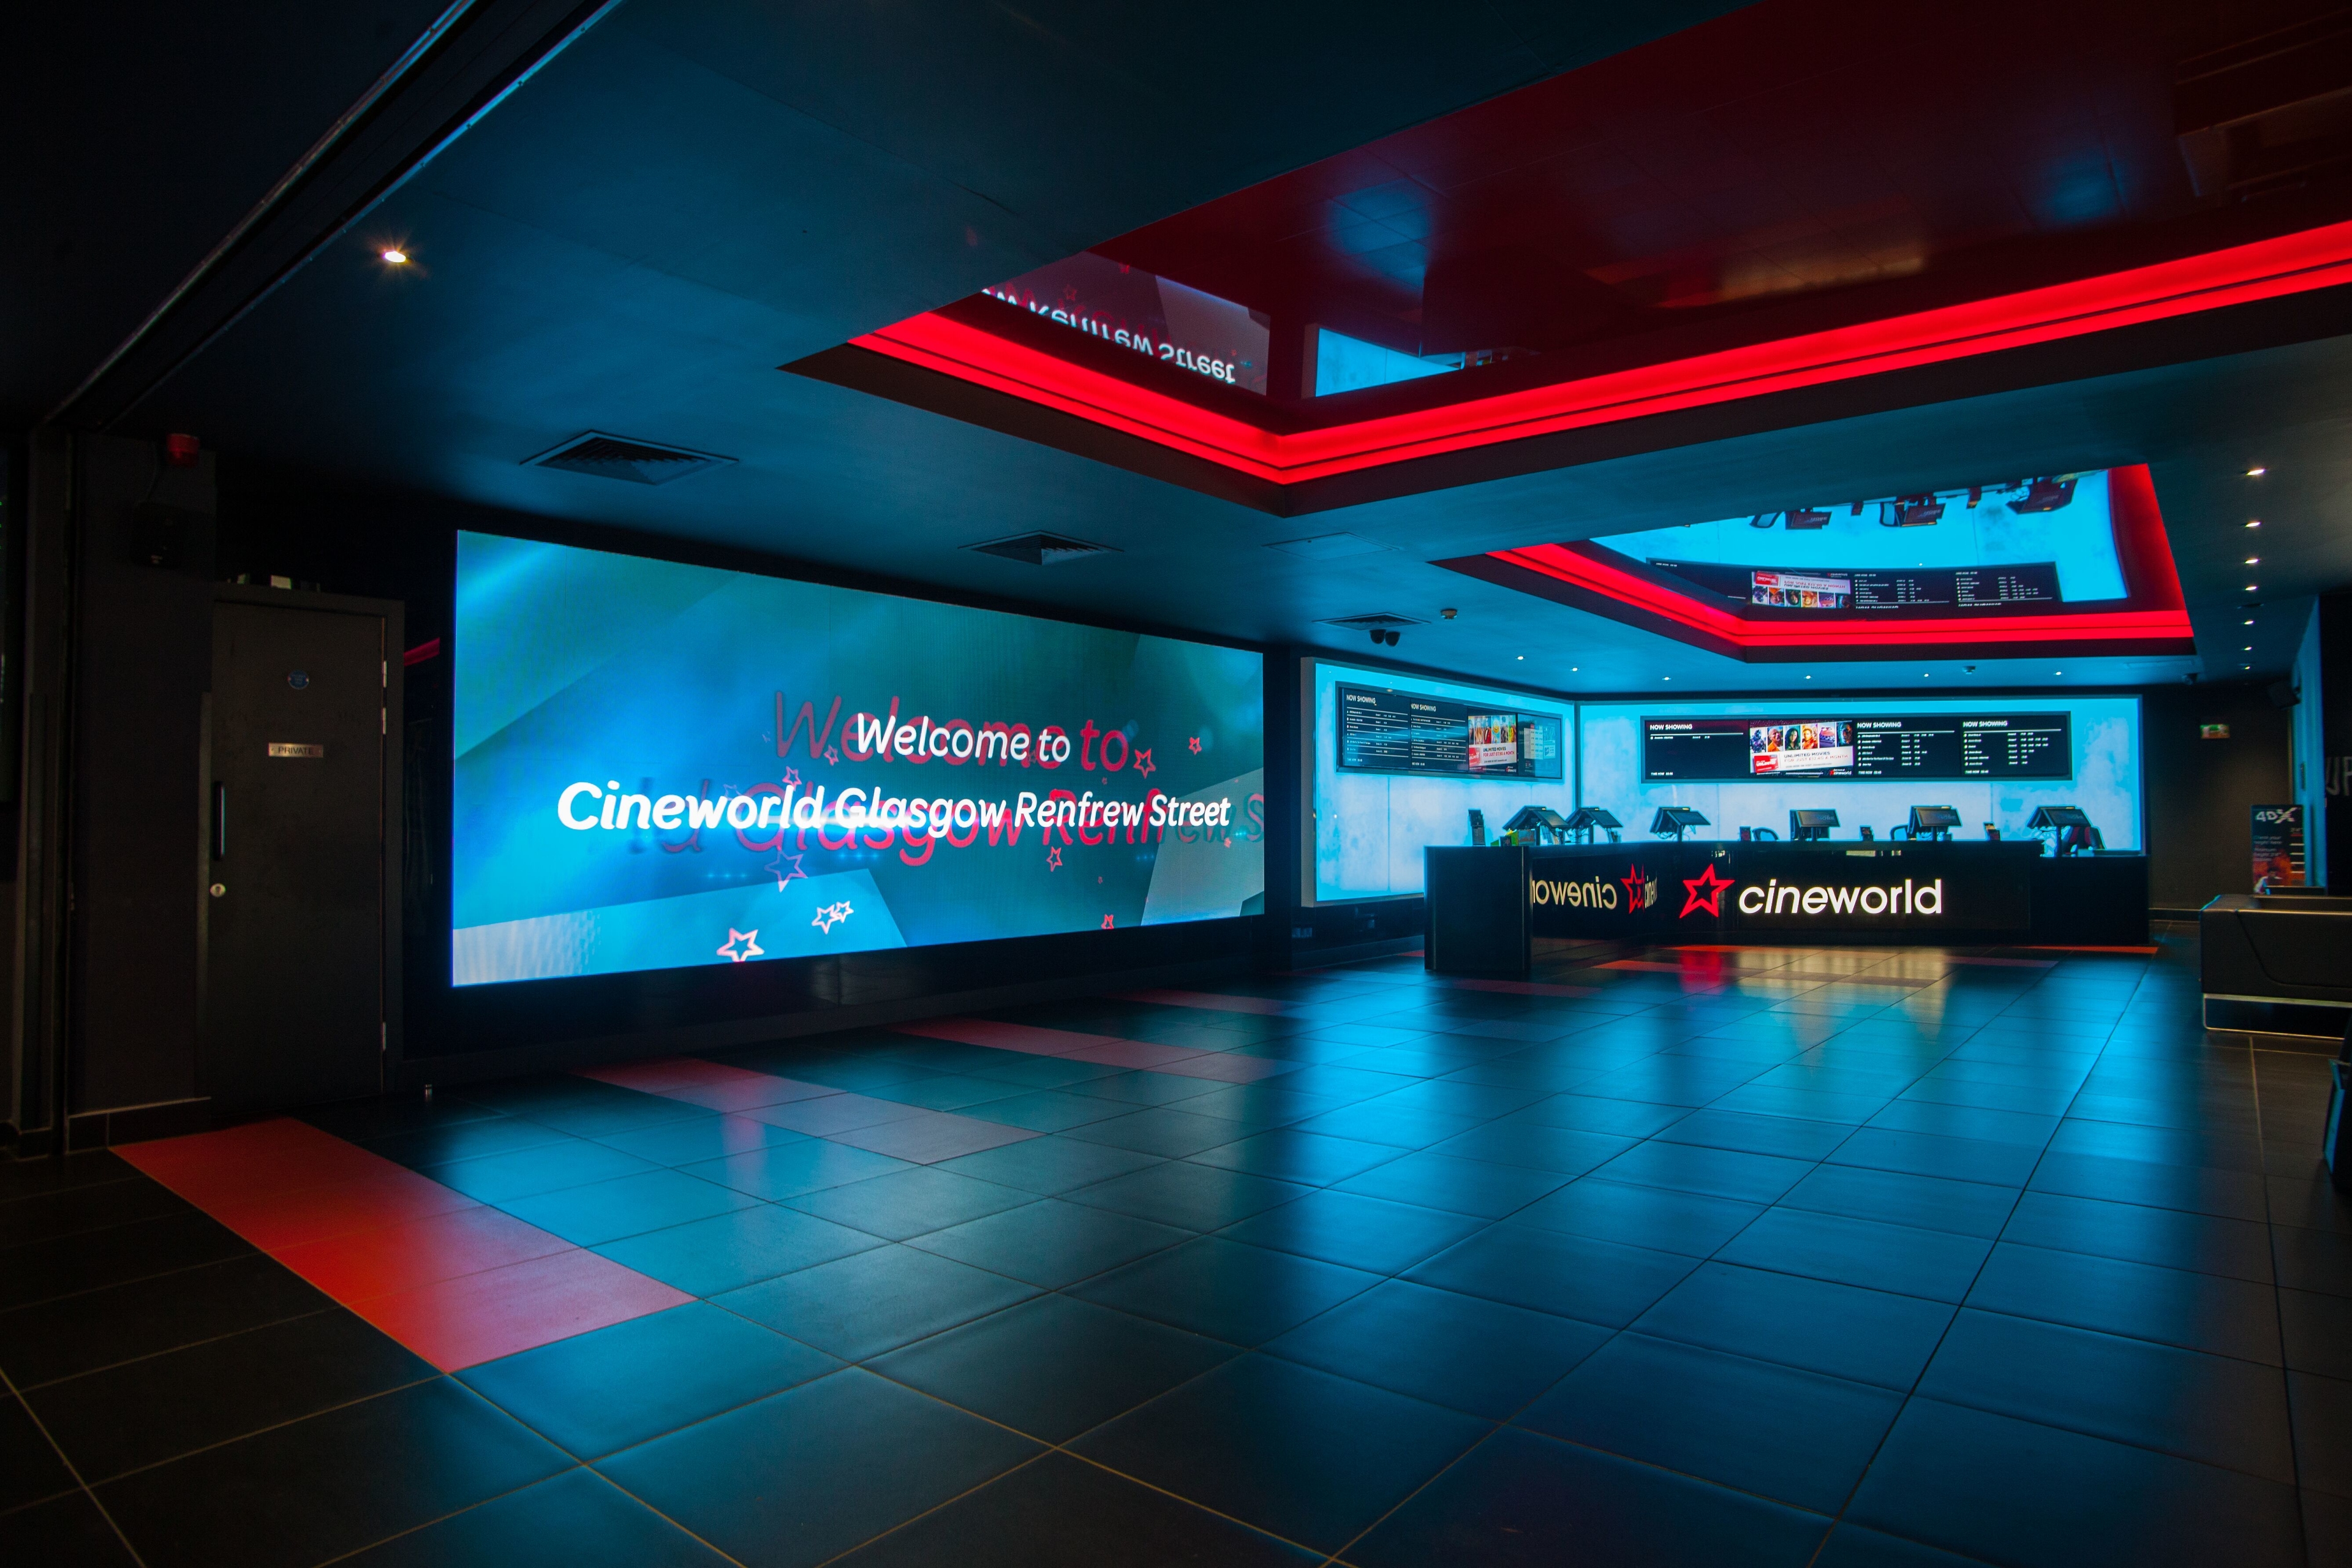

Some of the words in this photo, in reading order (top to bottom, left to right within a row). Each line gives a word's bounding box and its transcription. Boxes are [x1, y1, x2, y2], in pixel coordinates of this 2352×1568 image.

[278, 747, 314, 755] PRIVATE
[857, 713, 1030, 762] Welcome
[1039, 729, 1071, 763] to
[557, 780, 825, 830] Cineworld
[835, 786, 1008, 839] Glasgow
[1014, 791, 1145, 827] Renfrew
[1149, 794, 1231, 827] Street
[1738, 879, 1942, 914] cineworld
